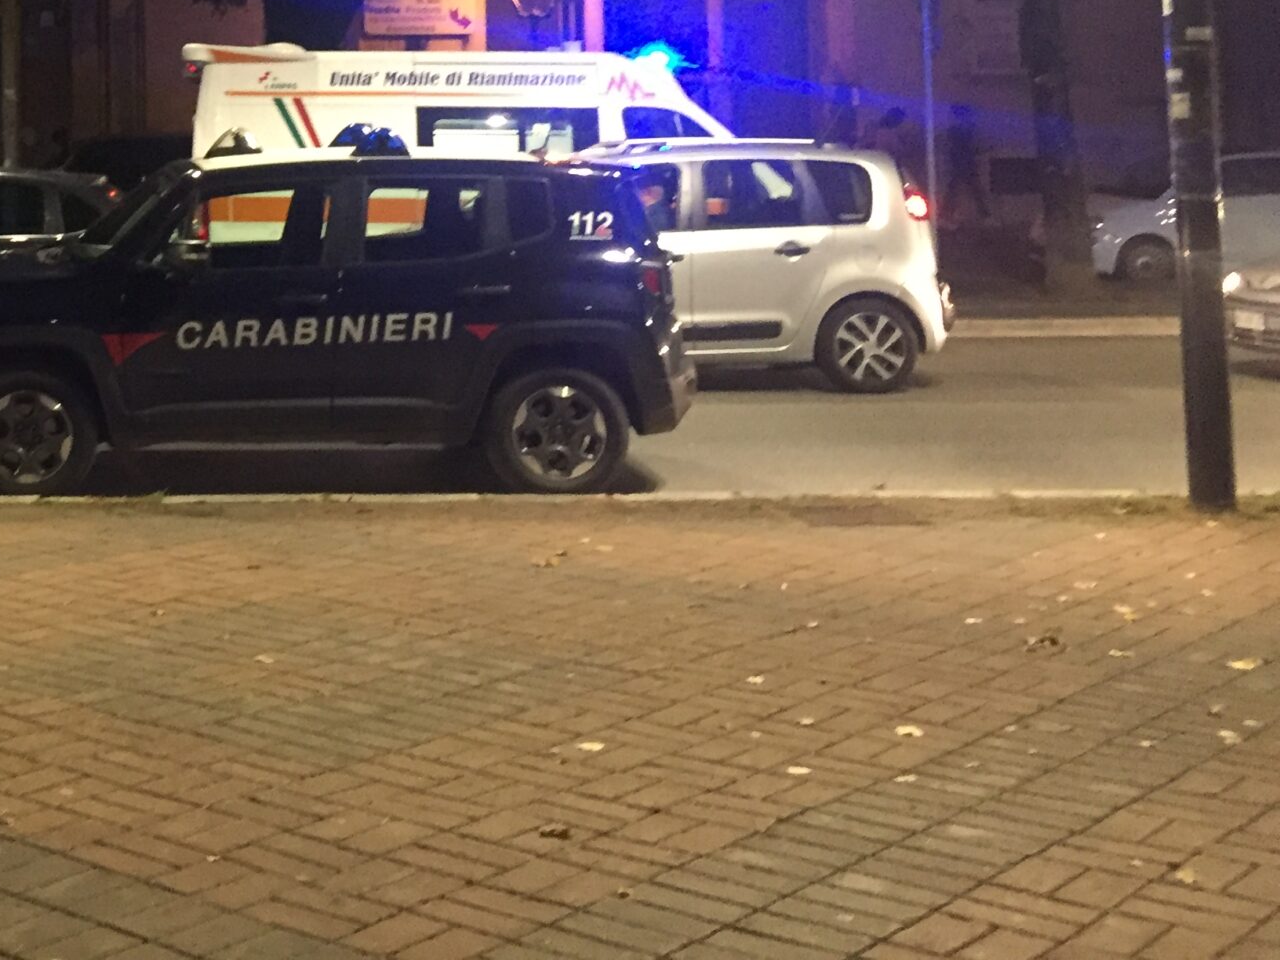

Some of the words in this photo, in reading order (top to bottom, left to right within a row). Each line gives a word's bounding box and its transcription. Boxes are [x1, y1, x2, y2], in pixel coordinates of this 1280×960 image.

[383, 71, 440, 87] Mobile
[445, 71, 462, 86] di
[467, 71, 586, 87] Rianimazione
[567, 211, 614, 237] 112
[175, 311, 454, 350] CARABINIERI
